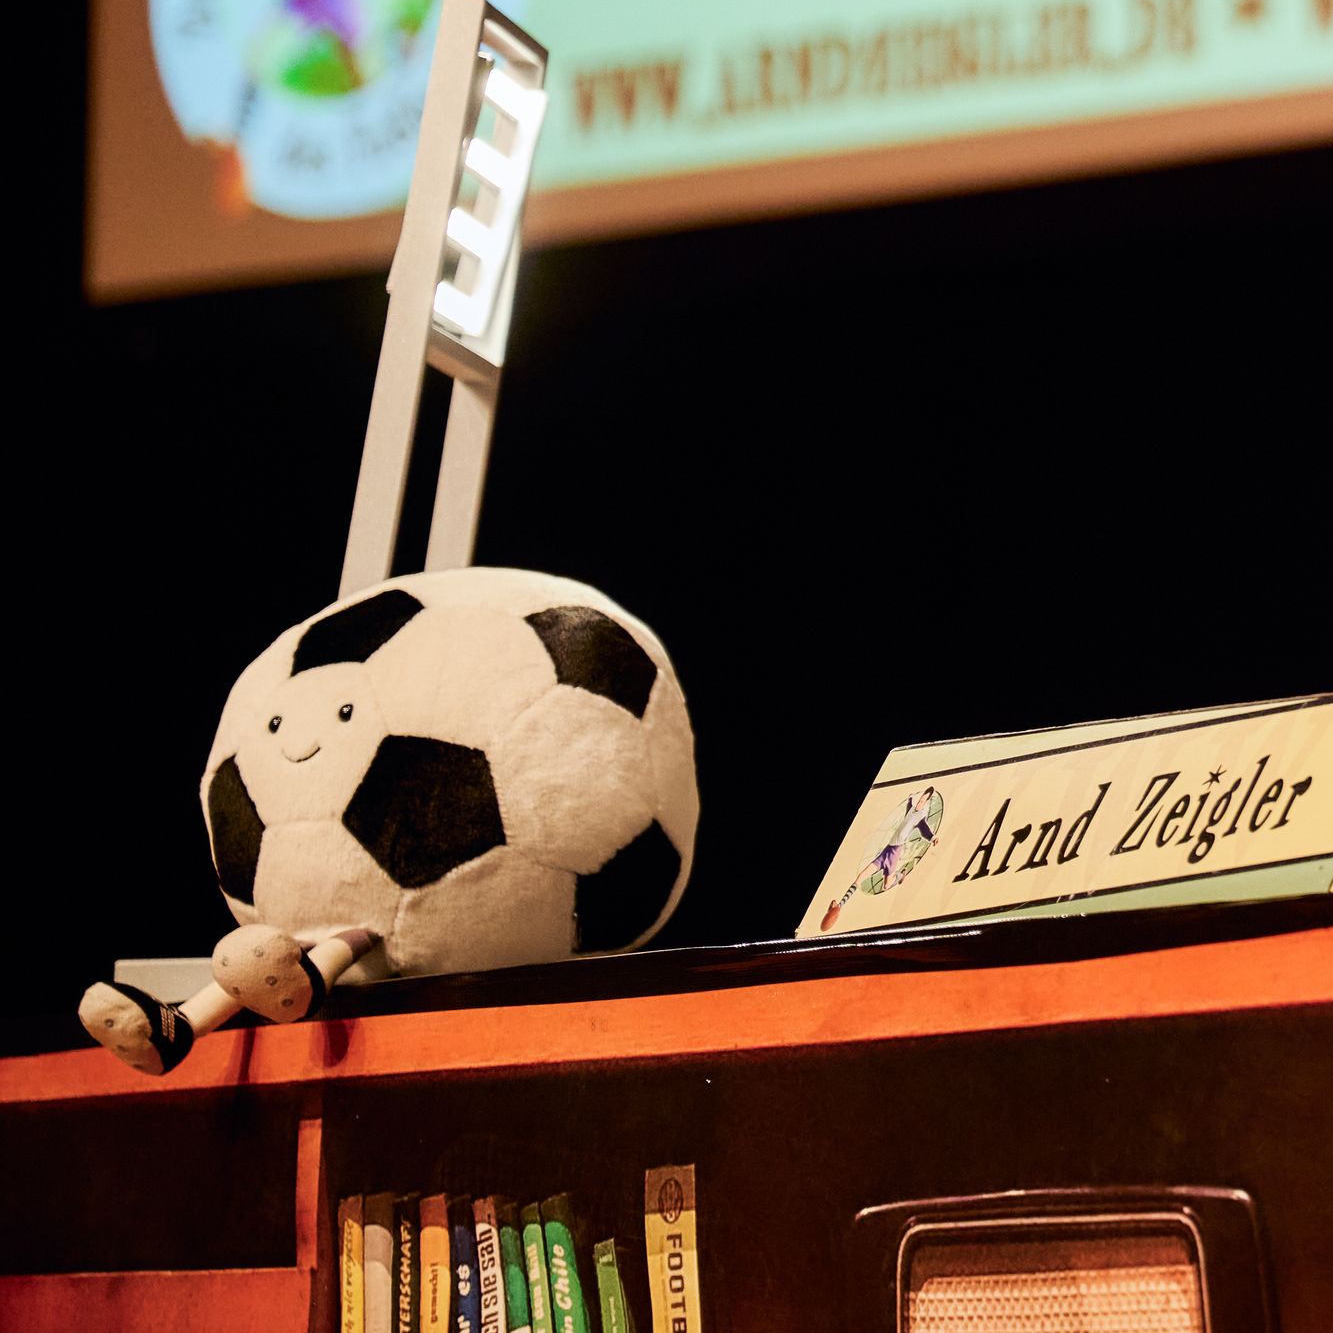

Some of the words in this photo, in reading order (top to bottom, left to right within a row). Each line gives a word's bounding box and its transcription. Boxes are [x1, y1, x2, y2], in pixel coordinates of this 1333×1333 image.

[951, 781, 1113, 884] Arnd
[1109, 753, 1314, 865] Zeigler
[457, 1263, 471, 1297] es
[552, 1242, 573, 1311] Chile
